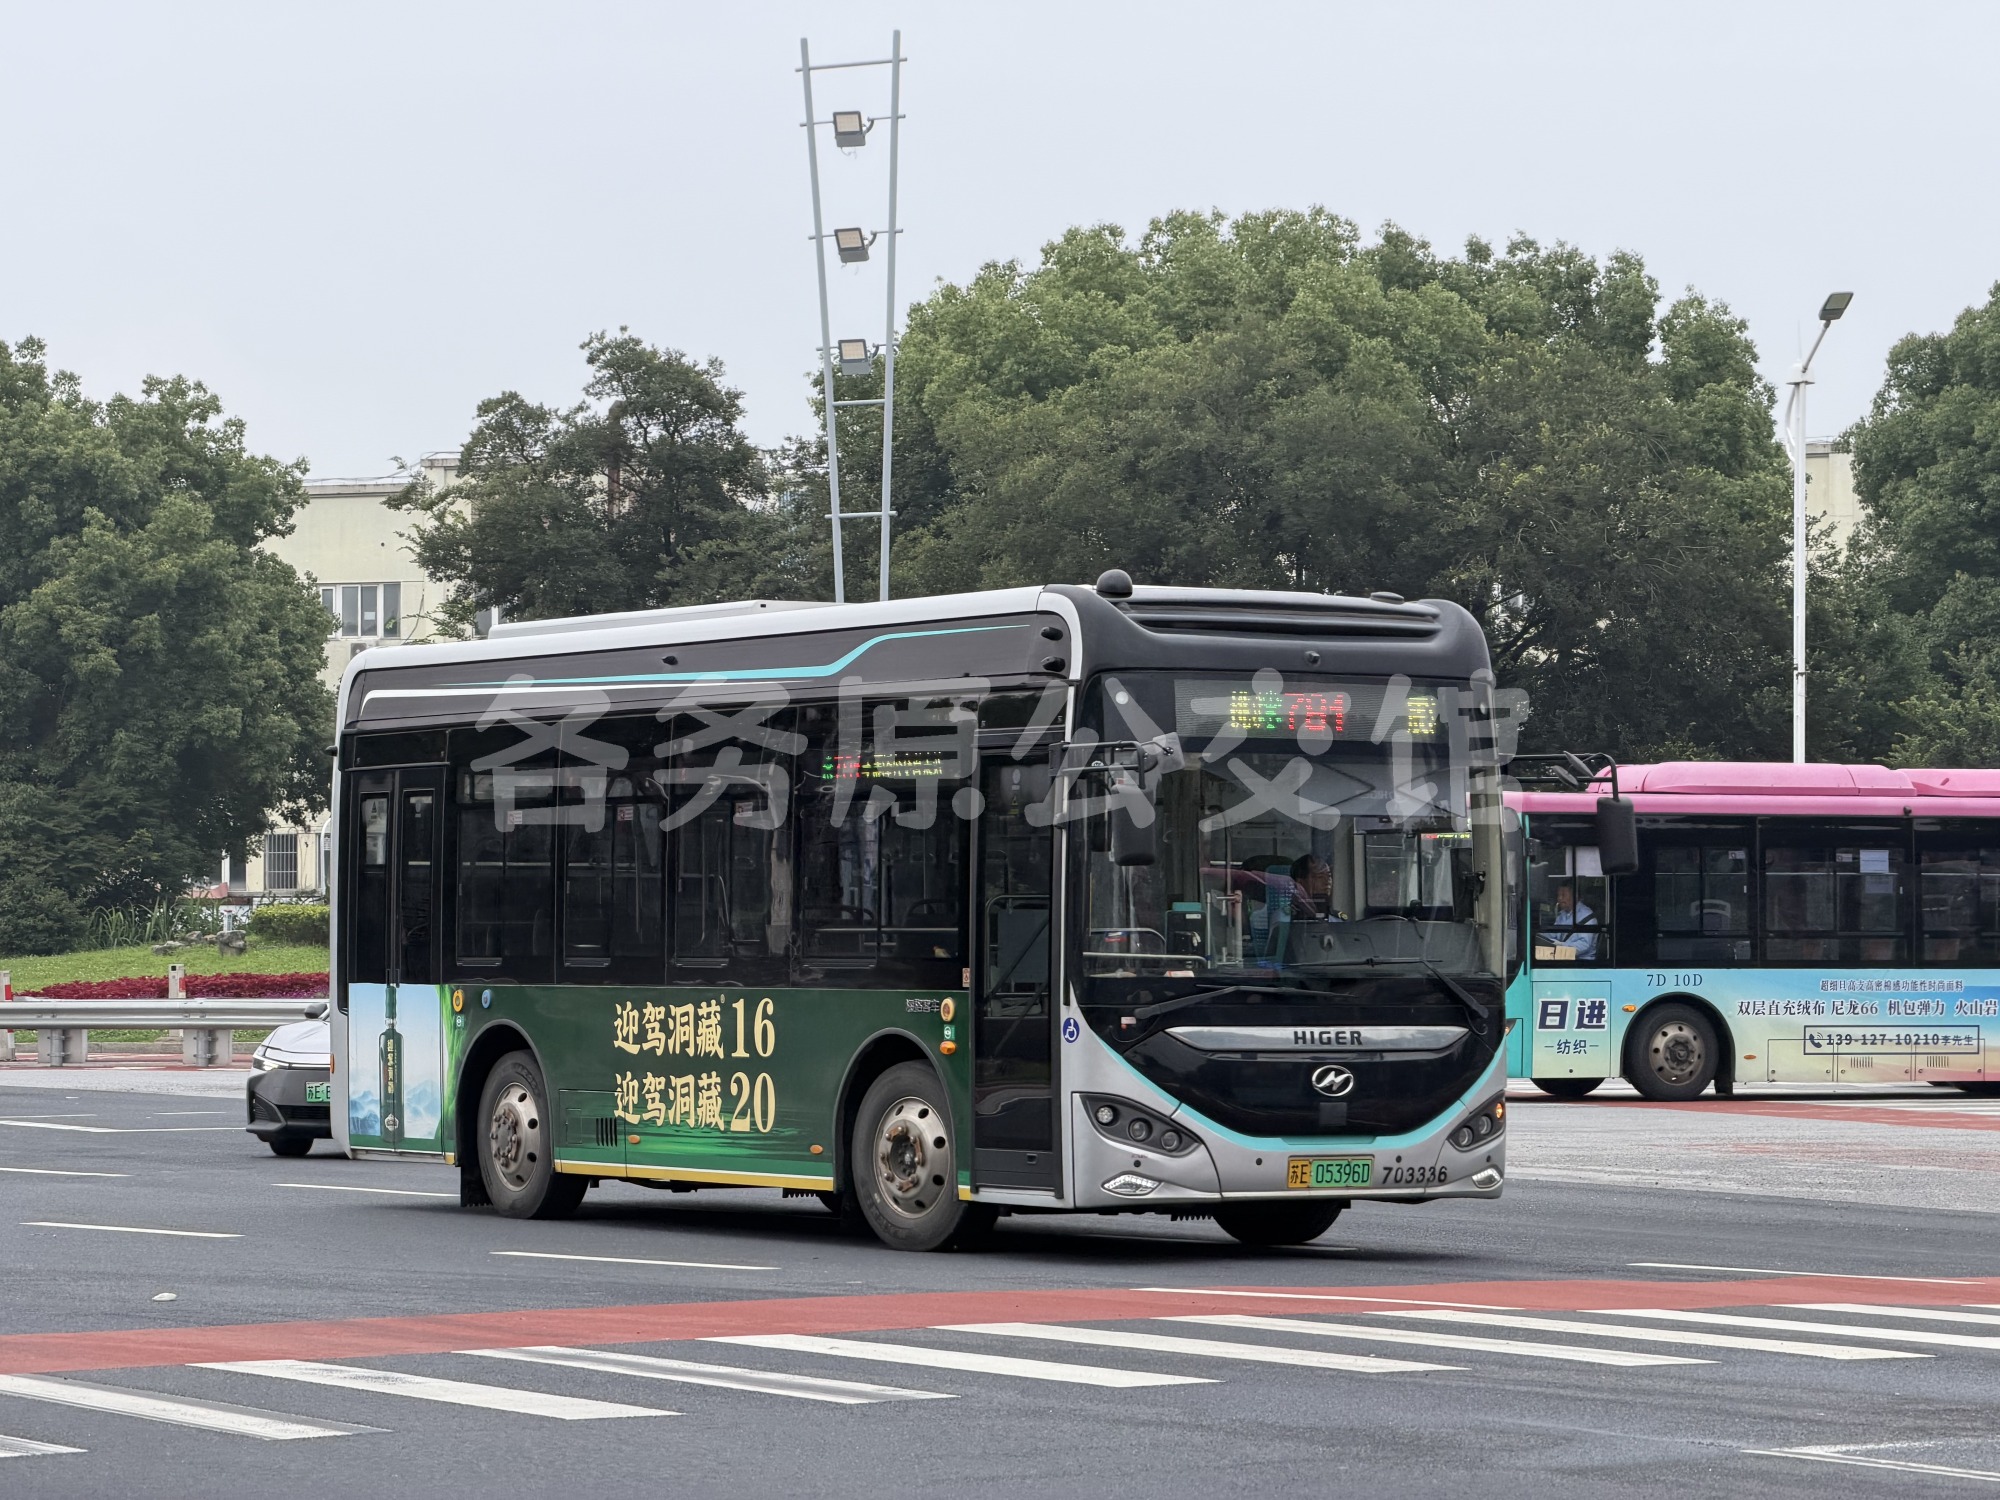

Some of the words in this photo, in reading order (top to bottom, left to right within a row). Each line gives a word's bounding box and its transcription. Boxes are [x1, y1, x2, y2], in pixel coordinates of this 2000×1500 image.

[1646, 974, 1667, 987] 7D
[1673, 974, 1703, 987] 10D
[1538, 999, 1607, 1030] 日进
[1737, 1000, 1826, 1016] 双层直充绒布
[1830, 1000, 1878, 1016] 尼龙66
[1887, 1000, 1946, 1016] 机包弹力
[1953, 1000, 1999, 1016] 火山岩
[1293, 1030, 1363, 1046] HIGER
[1382, 1165, 1448, 1185] 703336
